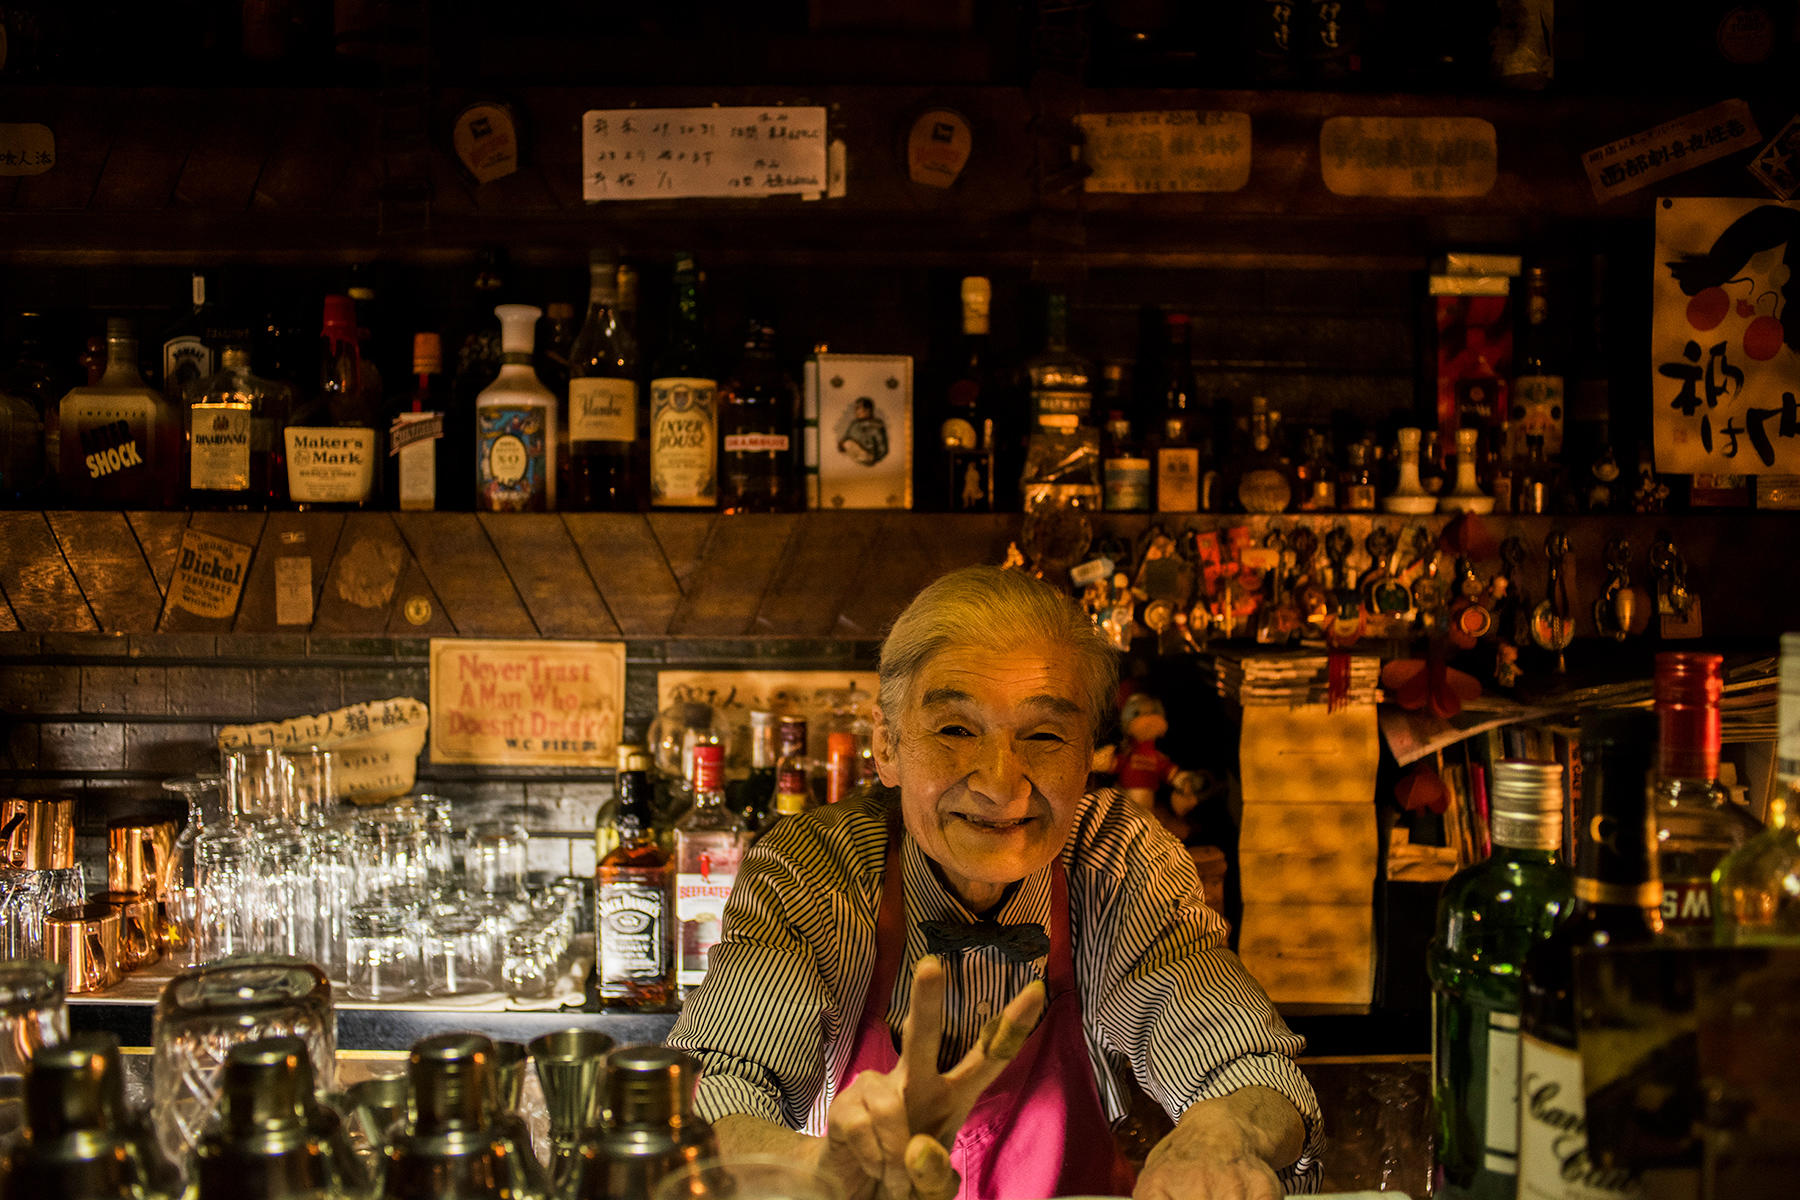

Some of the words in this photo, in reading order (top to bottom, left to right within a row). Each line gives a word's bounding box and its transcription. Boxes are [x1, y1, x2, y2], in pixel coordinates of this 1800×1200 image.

[294, 435, 363, 449] Maker's
[85, 440, 143, 479] SHOCK
[312, 451, 363, 465] Mark
[180, 547, 241, 585] Dickel
[458, 655, 526, 681] Never
[528, 655, 591, 683] Trust
[459, 682, 475, 707] A
[480, 682, 522, 708] Man
[529, 682, 578, 710] Who
[448, 709, 525, 738] Doesn't
